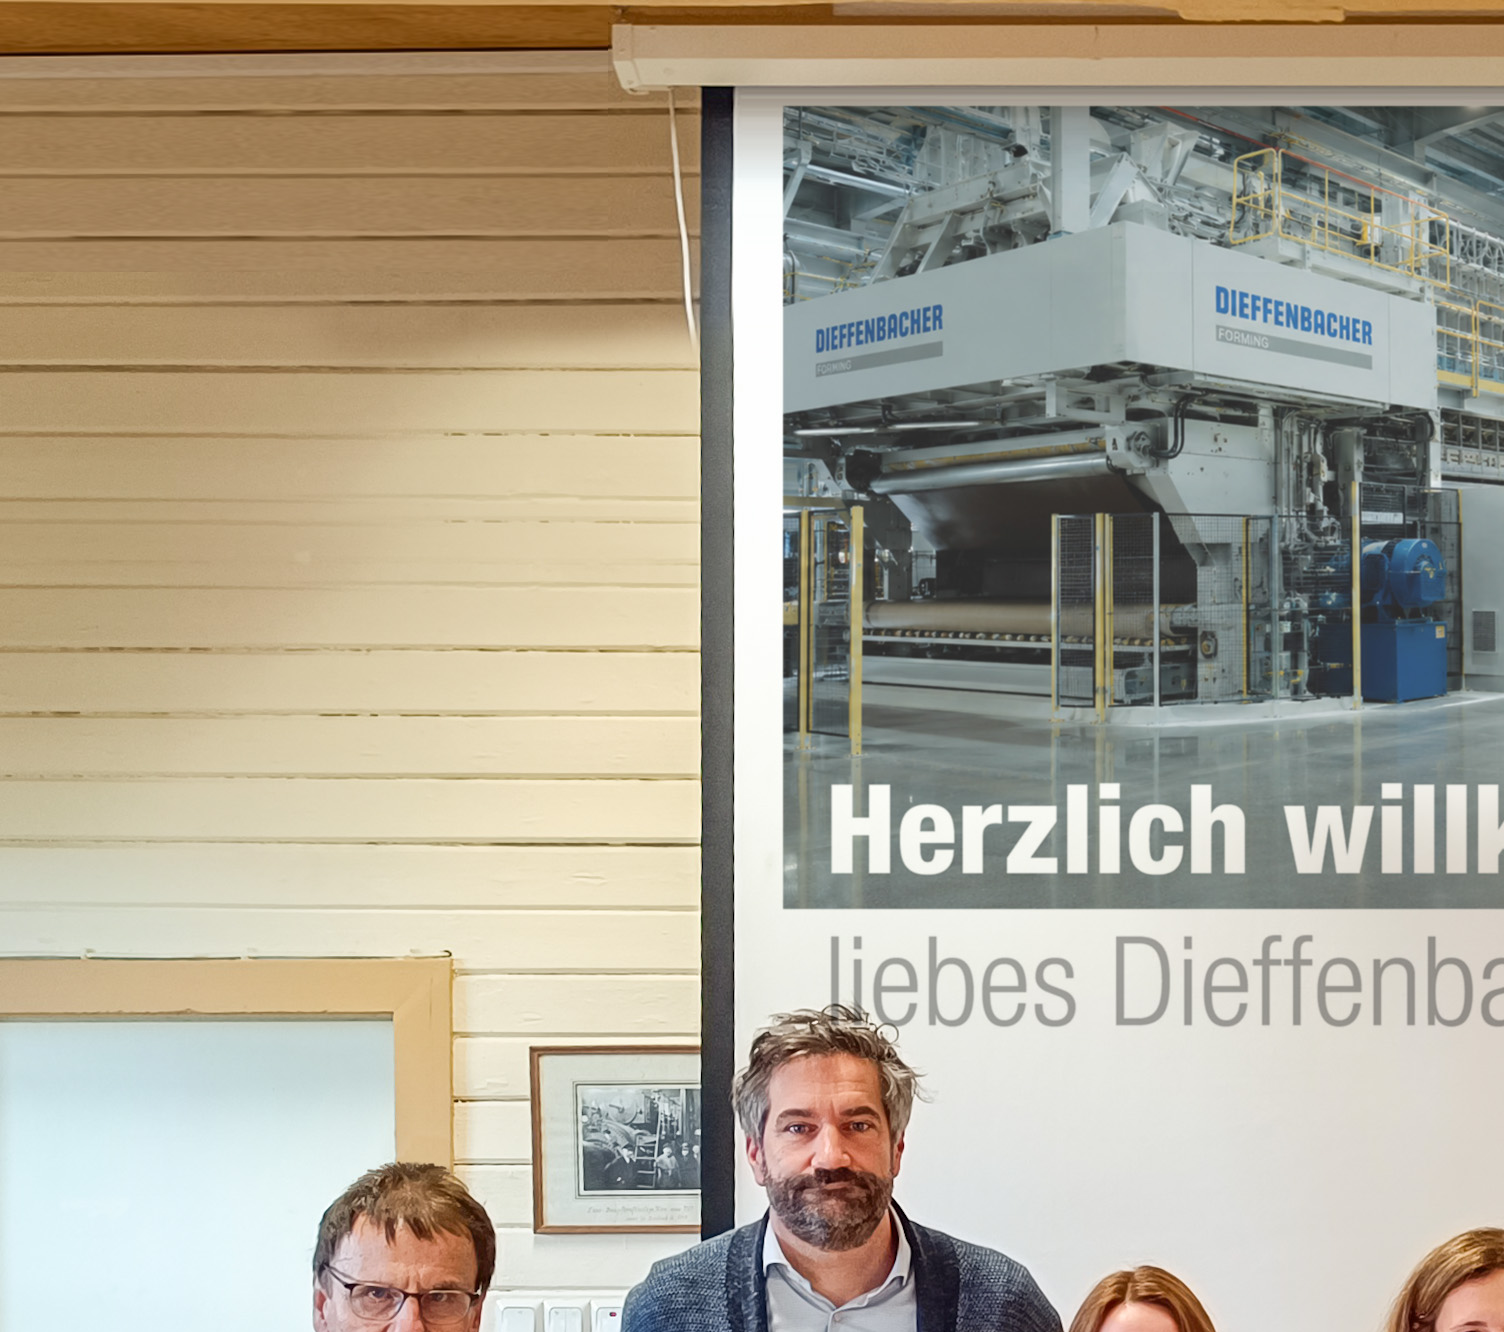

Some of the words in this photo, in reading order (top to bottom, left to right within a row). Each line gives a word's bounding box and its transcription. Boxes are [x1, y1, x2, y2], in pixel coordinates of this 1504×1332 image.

[815, 304, 943, 353] DIEFFENBACHER
[1215, 285, 1373, 346] DIEFFENBACHER
[1218, 327, 1269, 349] FORMING
[830, 782, 1246, 876] Herzlich
[830, 935, 1077, 1027] liebes
